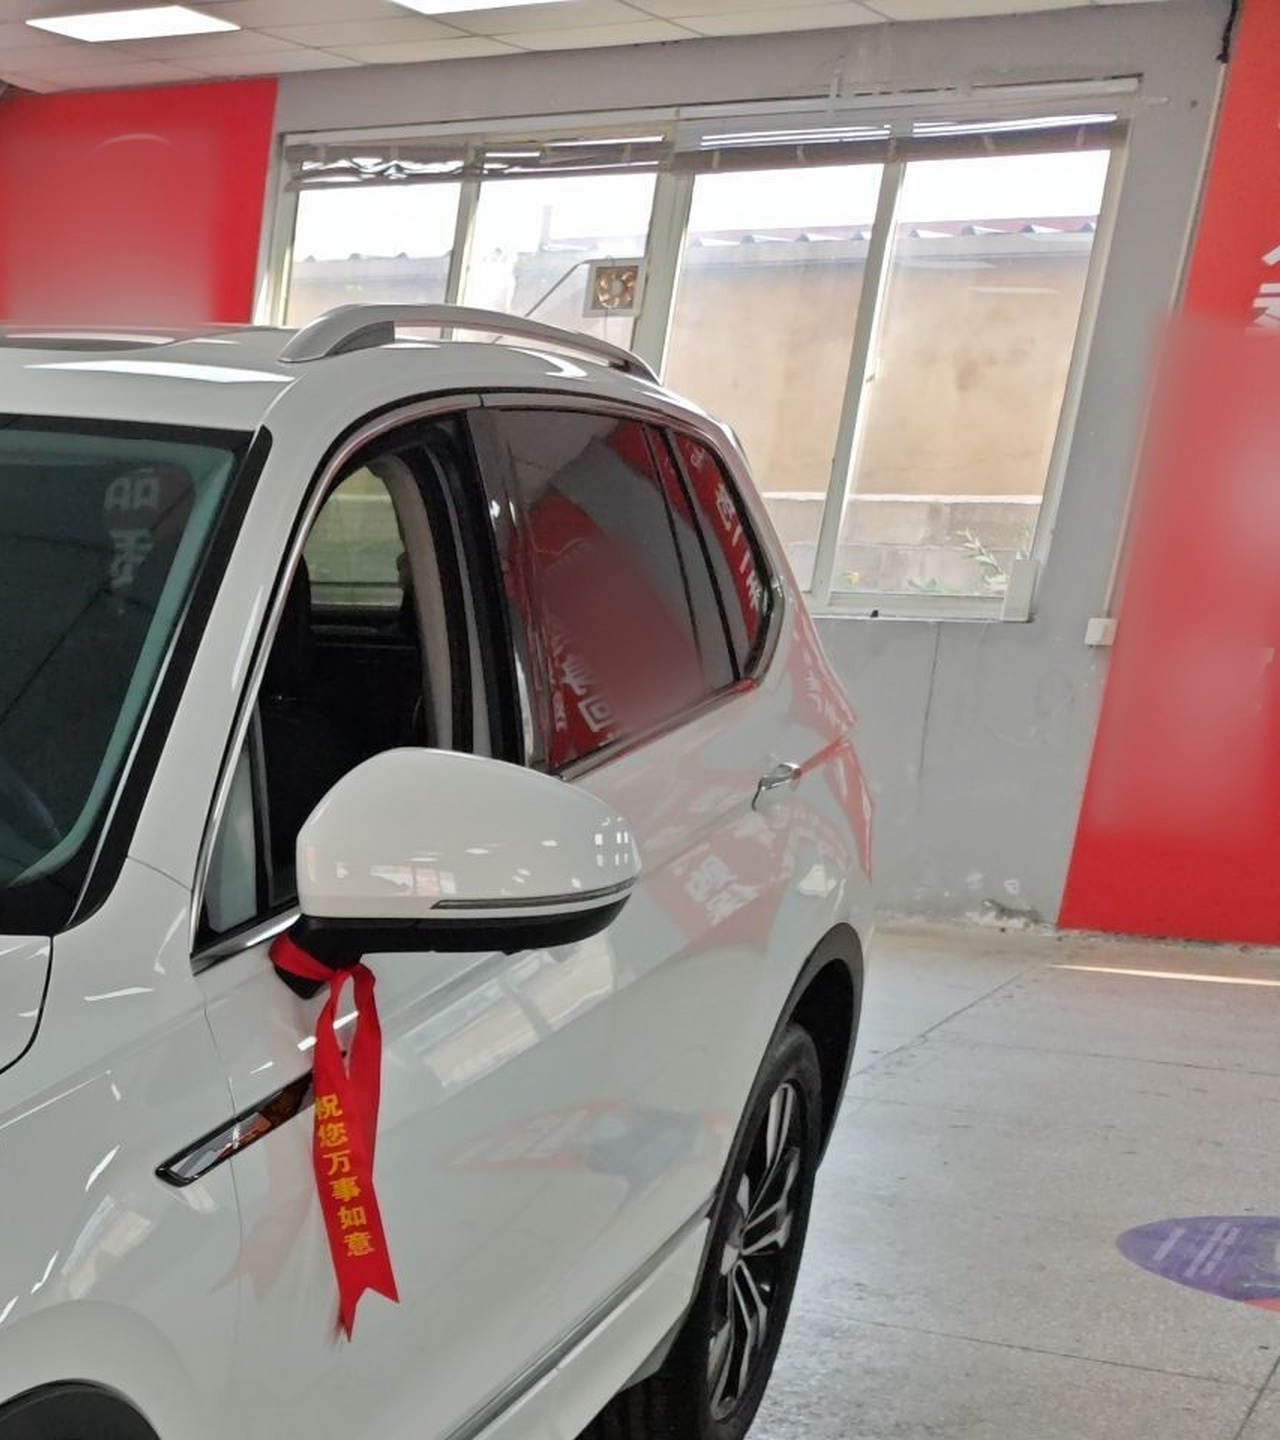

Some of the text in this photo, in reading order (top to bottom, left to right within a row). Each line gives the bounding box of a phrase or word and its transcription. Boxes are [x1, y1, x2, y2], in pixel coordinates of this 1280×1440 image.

[314, 1093, 375, 1258] 祝您万事如意
